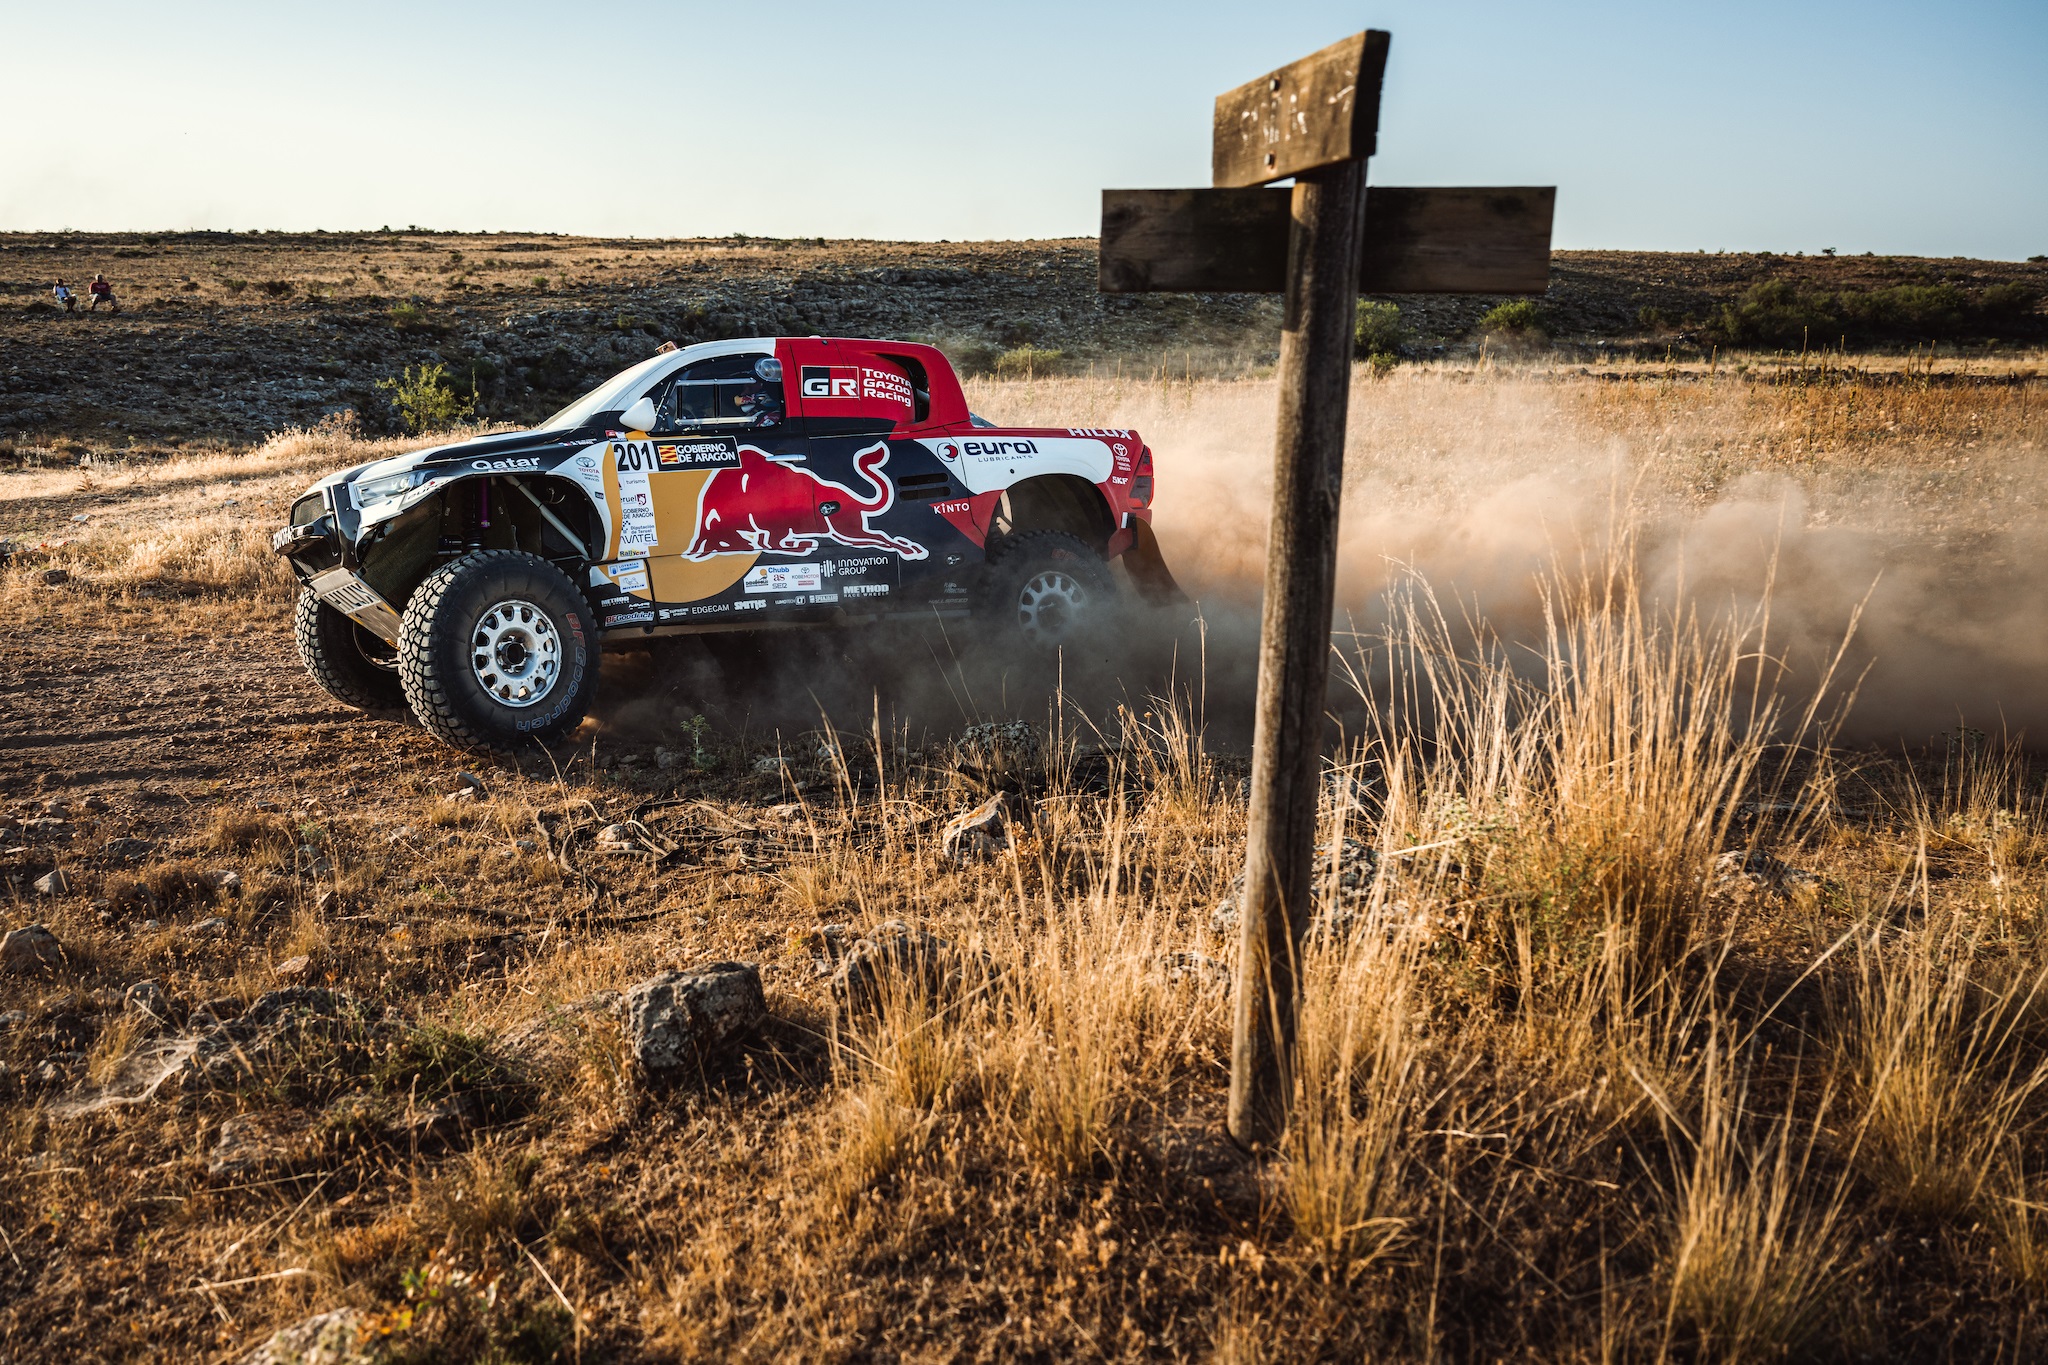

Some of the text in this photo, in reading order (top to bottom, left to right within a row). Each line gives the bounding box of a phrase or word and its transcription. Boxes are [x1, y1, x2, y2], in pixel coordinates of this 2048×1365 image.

[862, 368, 912, 388] TOYOTA
[804, 378, 857, 395] GR
[863, 378, 911, 395] GAZOO
[864, 388, 911, 407] Racing
[676, 443, 726, 453] GOBIERNO
[964, 440, 1038, 455] eurol
[614, 442, 653, 471] 201
[679, 451, 736, 463] DE ARAGON
[471, 457, 540, 470] Qatar
[1112, 476, 1128, 485] SKF
[935, 503, 970, 514] KINTO
[838, 556, 888, 568] INNOVATION
[838, 566, 867, 576] GROUP
[773, 574, 786, 582] as
[843, 584, 890, 594] METHOD
[692, 604, 730, 615] EDGECAM
[734, 600, 767, 610] SMITHS
[605, 611, 655, 624] BFGoodrich
[517, 613, 587, 733] BFGoodrich
